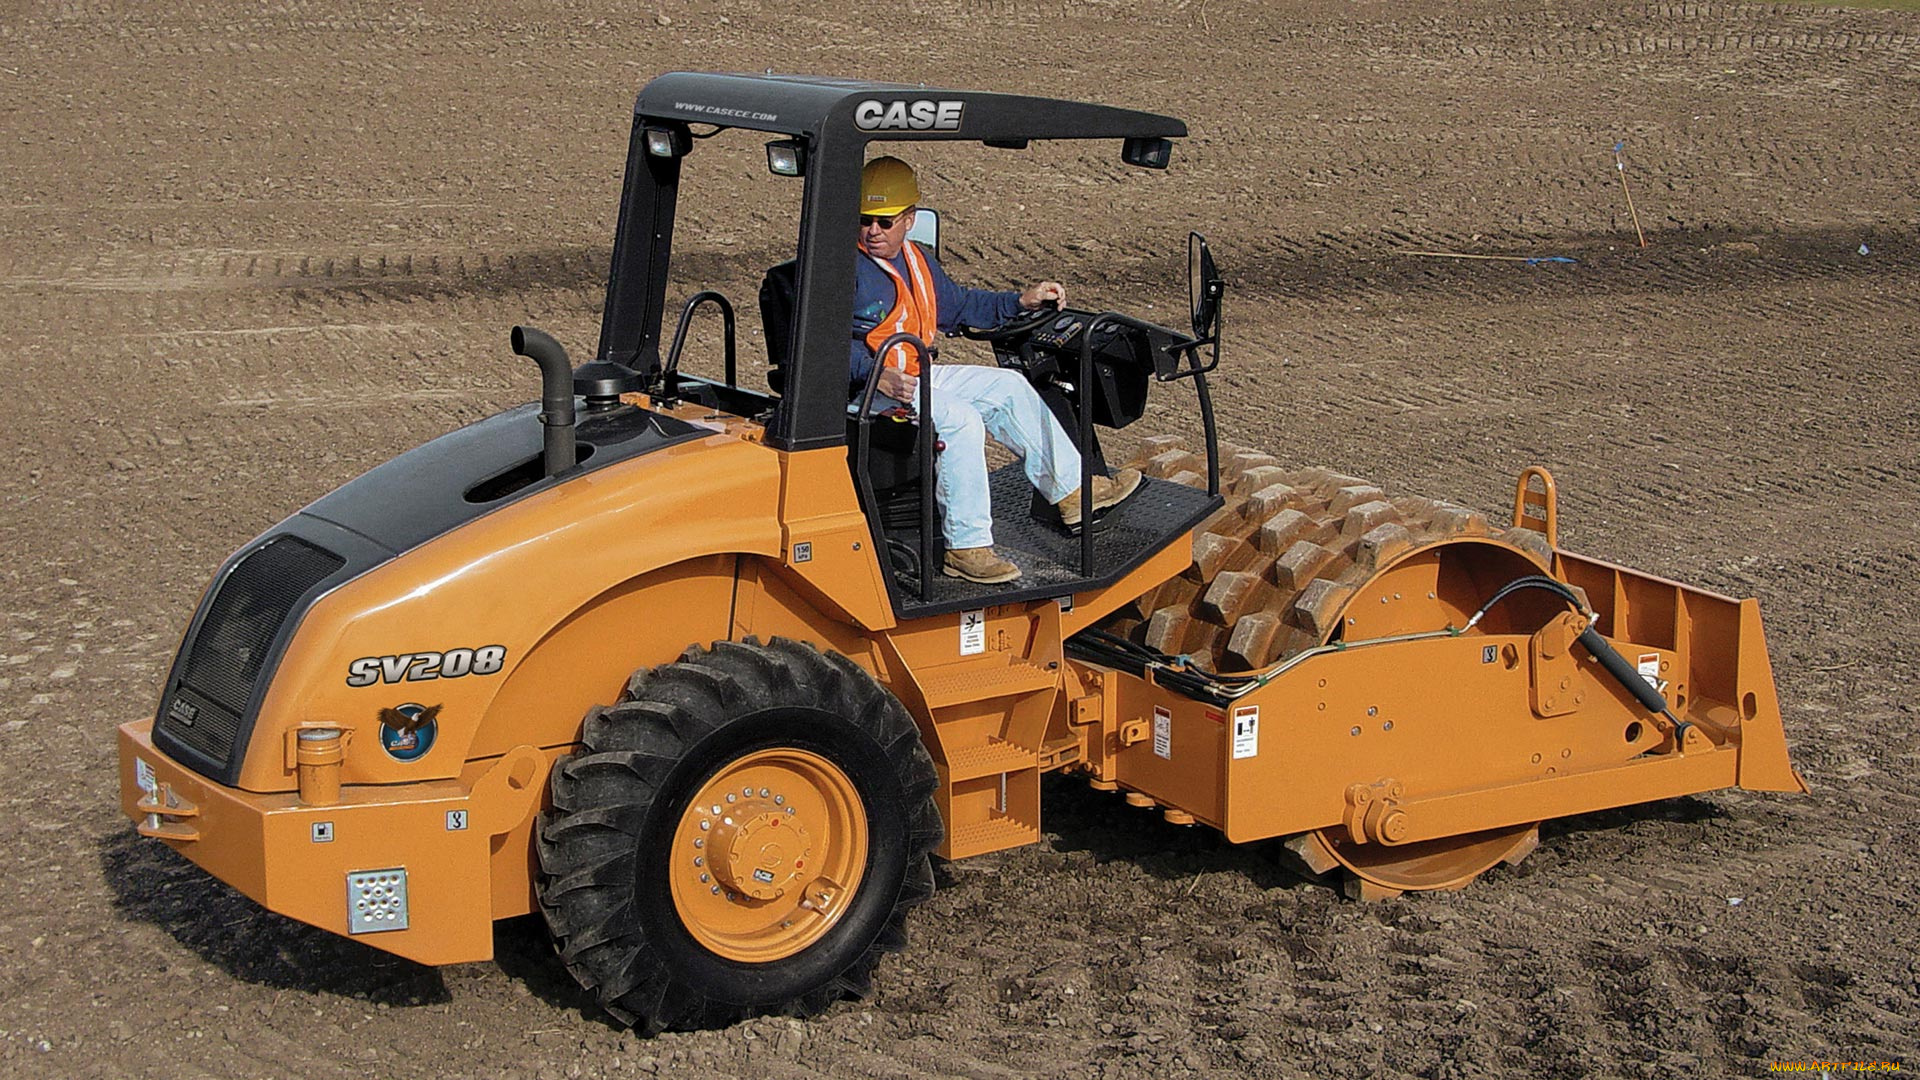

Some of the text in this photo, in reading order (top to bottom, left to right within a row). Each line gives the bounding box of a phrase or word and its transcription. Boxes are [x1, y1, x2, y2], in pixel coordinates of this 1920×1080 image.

[674, 102, 778, 121] WWW.CASECE.COM
[855, 99, 964, 130] CASE
[346, 644, 508, 688] SV208
[173, 699, 197, 720] CASE
